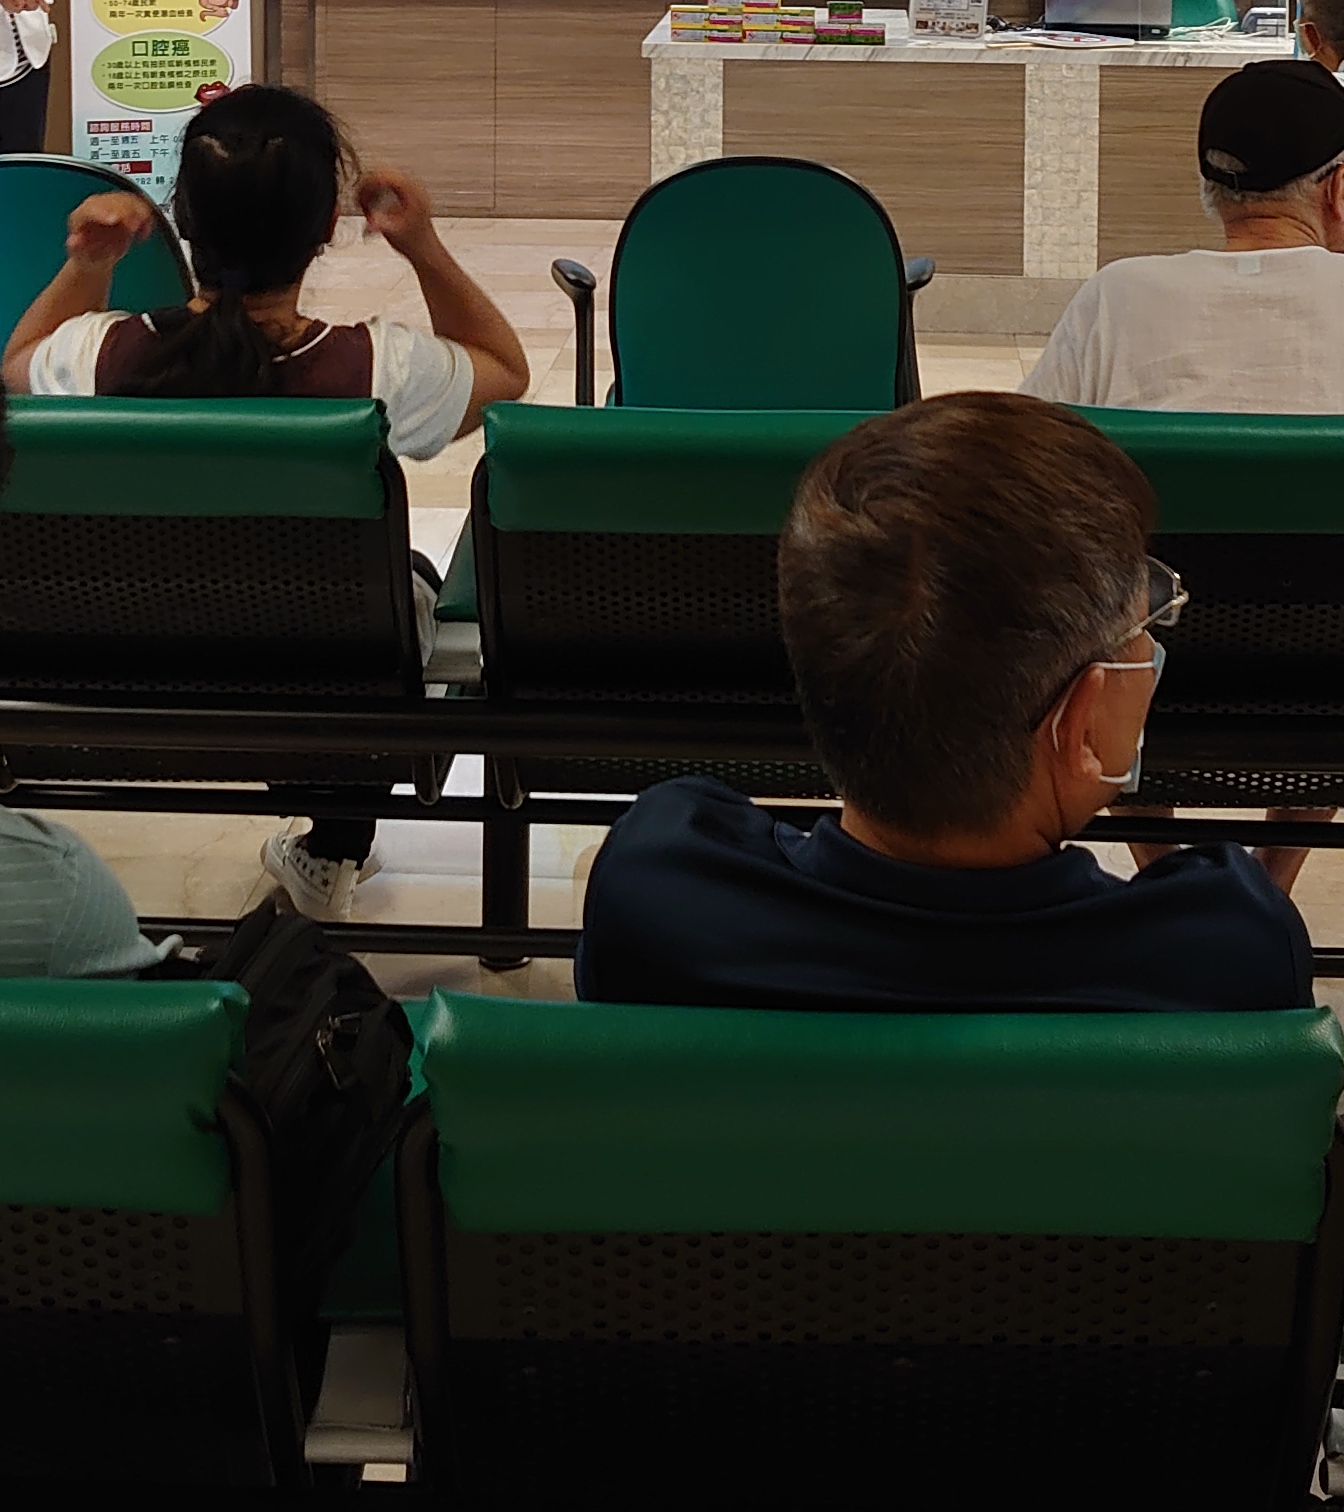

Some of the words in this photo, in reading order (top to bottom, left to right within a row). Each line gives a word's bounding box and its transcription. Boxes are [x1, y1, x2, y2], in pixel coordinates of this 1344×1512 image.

[132, 39, 191, 57] 口腔癌
[89, 135, 139, 146] 週一至週五
[149, 134, 169, 145] 上午
[89, 149, 141, 160] 週一至週五
[149, 148, 169, 159] 下午
